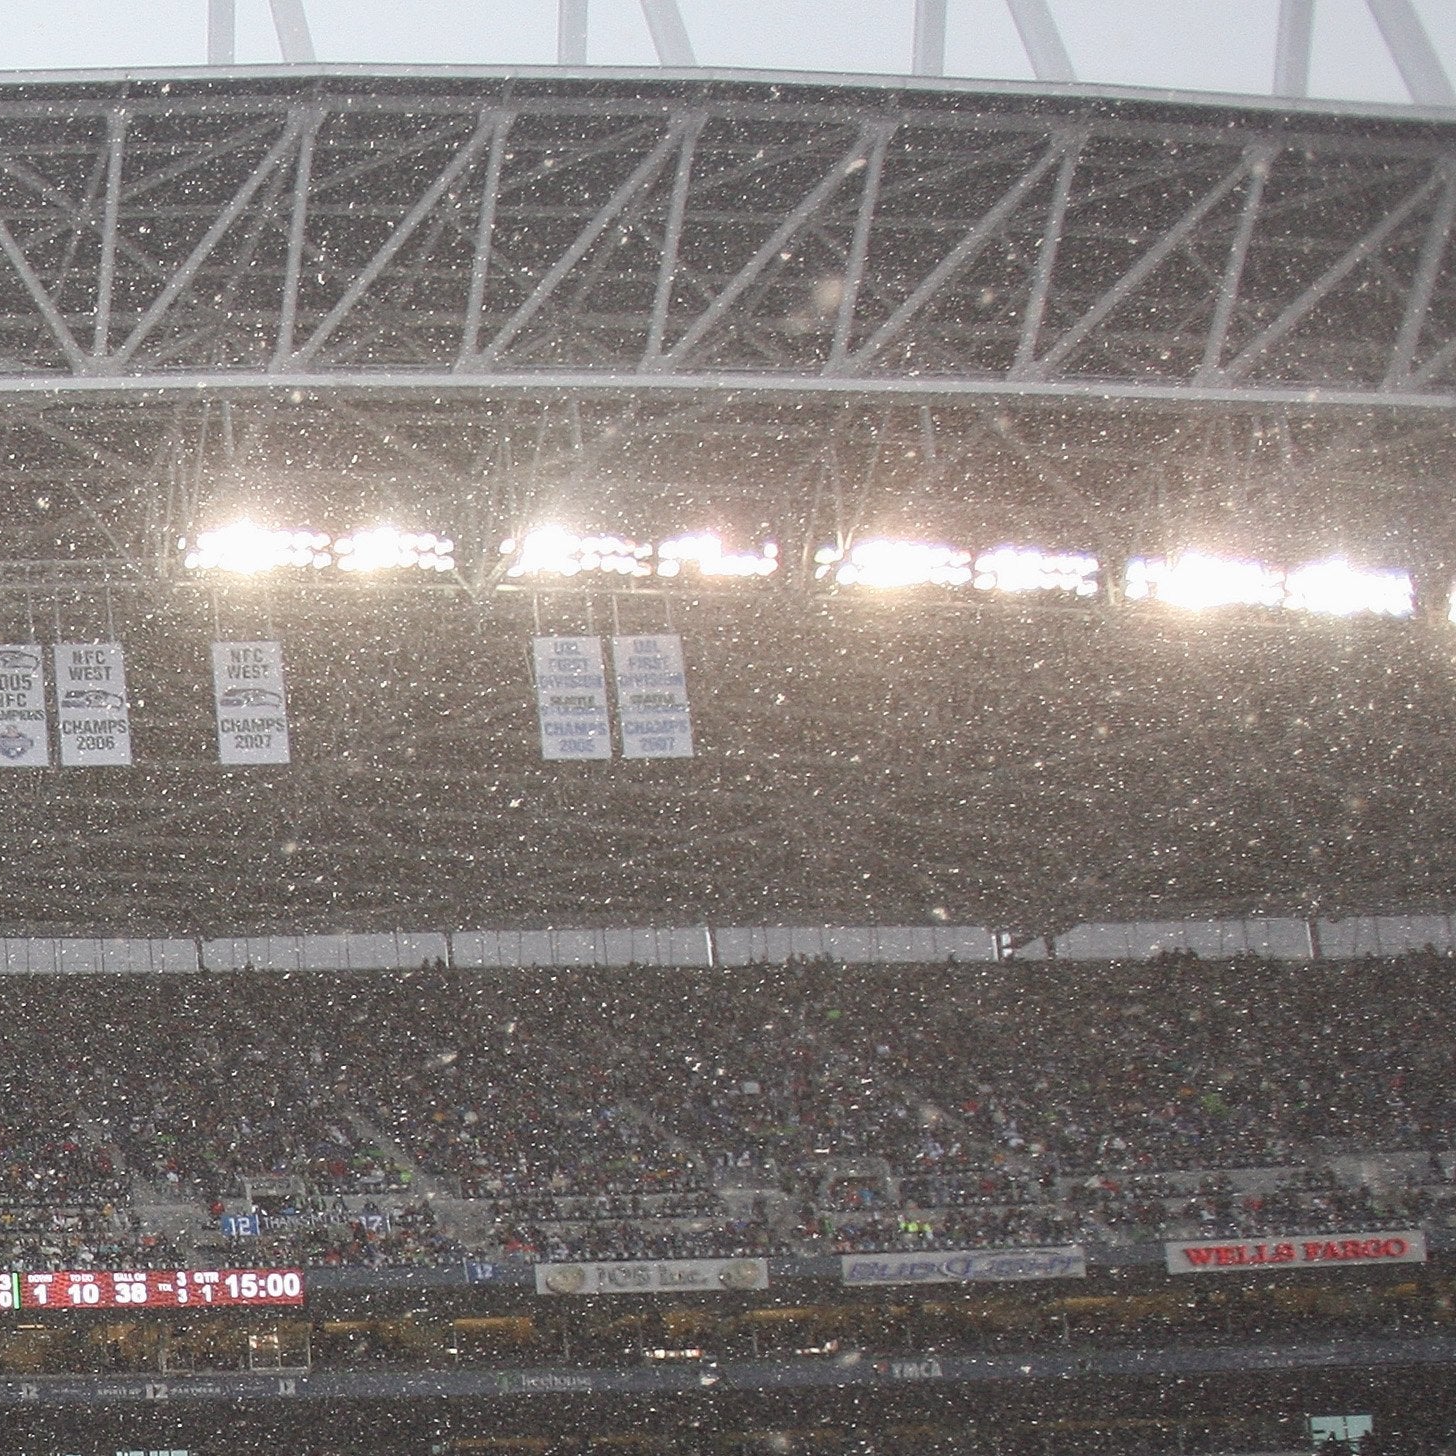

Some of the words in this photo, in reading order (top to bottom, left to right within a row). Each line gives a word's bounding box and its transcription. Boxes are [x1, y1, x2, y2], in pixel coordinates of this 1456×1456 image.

[72, 651, 106, 664] NFC
[230, 648, 264, 663] NFC
[68, 666, 112, 681] WEST
[227, 664, 269, 679] WEST
[62, 719, 127, 734] CHAMPS
[220, 719, 285, 733] CHAMPS
[234, 734, 272, 749] 2007
[229, 1218, 251, 1236] 12
[1184, 1242, 1296, 1266] WELLS
[1302, 1237, 1409, 1261] FARGO
[177, 1272, 187, 1287] 3
[193, 1271, 219, 1284] QTR
[67, 1283, 100, 1304] 10
[114, 1283, 148, 1304] 38
[225, 1273, 301, 1299] 15:00
[0, 1291, 12, 1308] 0
[33, 1285, 47, 1305] 1
[177, 1288, 188, 1303] 3
[201, 1285, 213, 1303] 1
